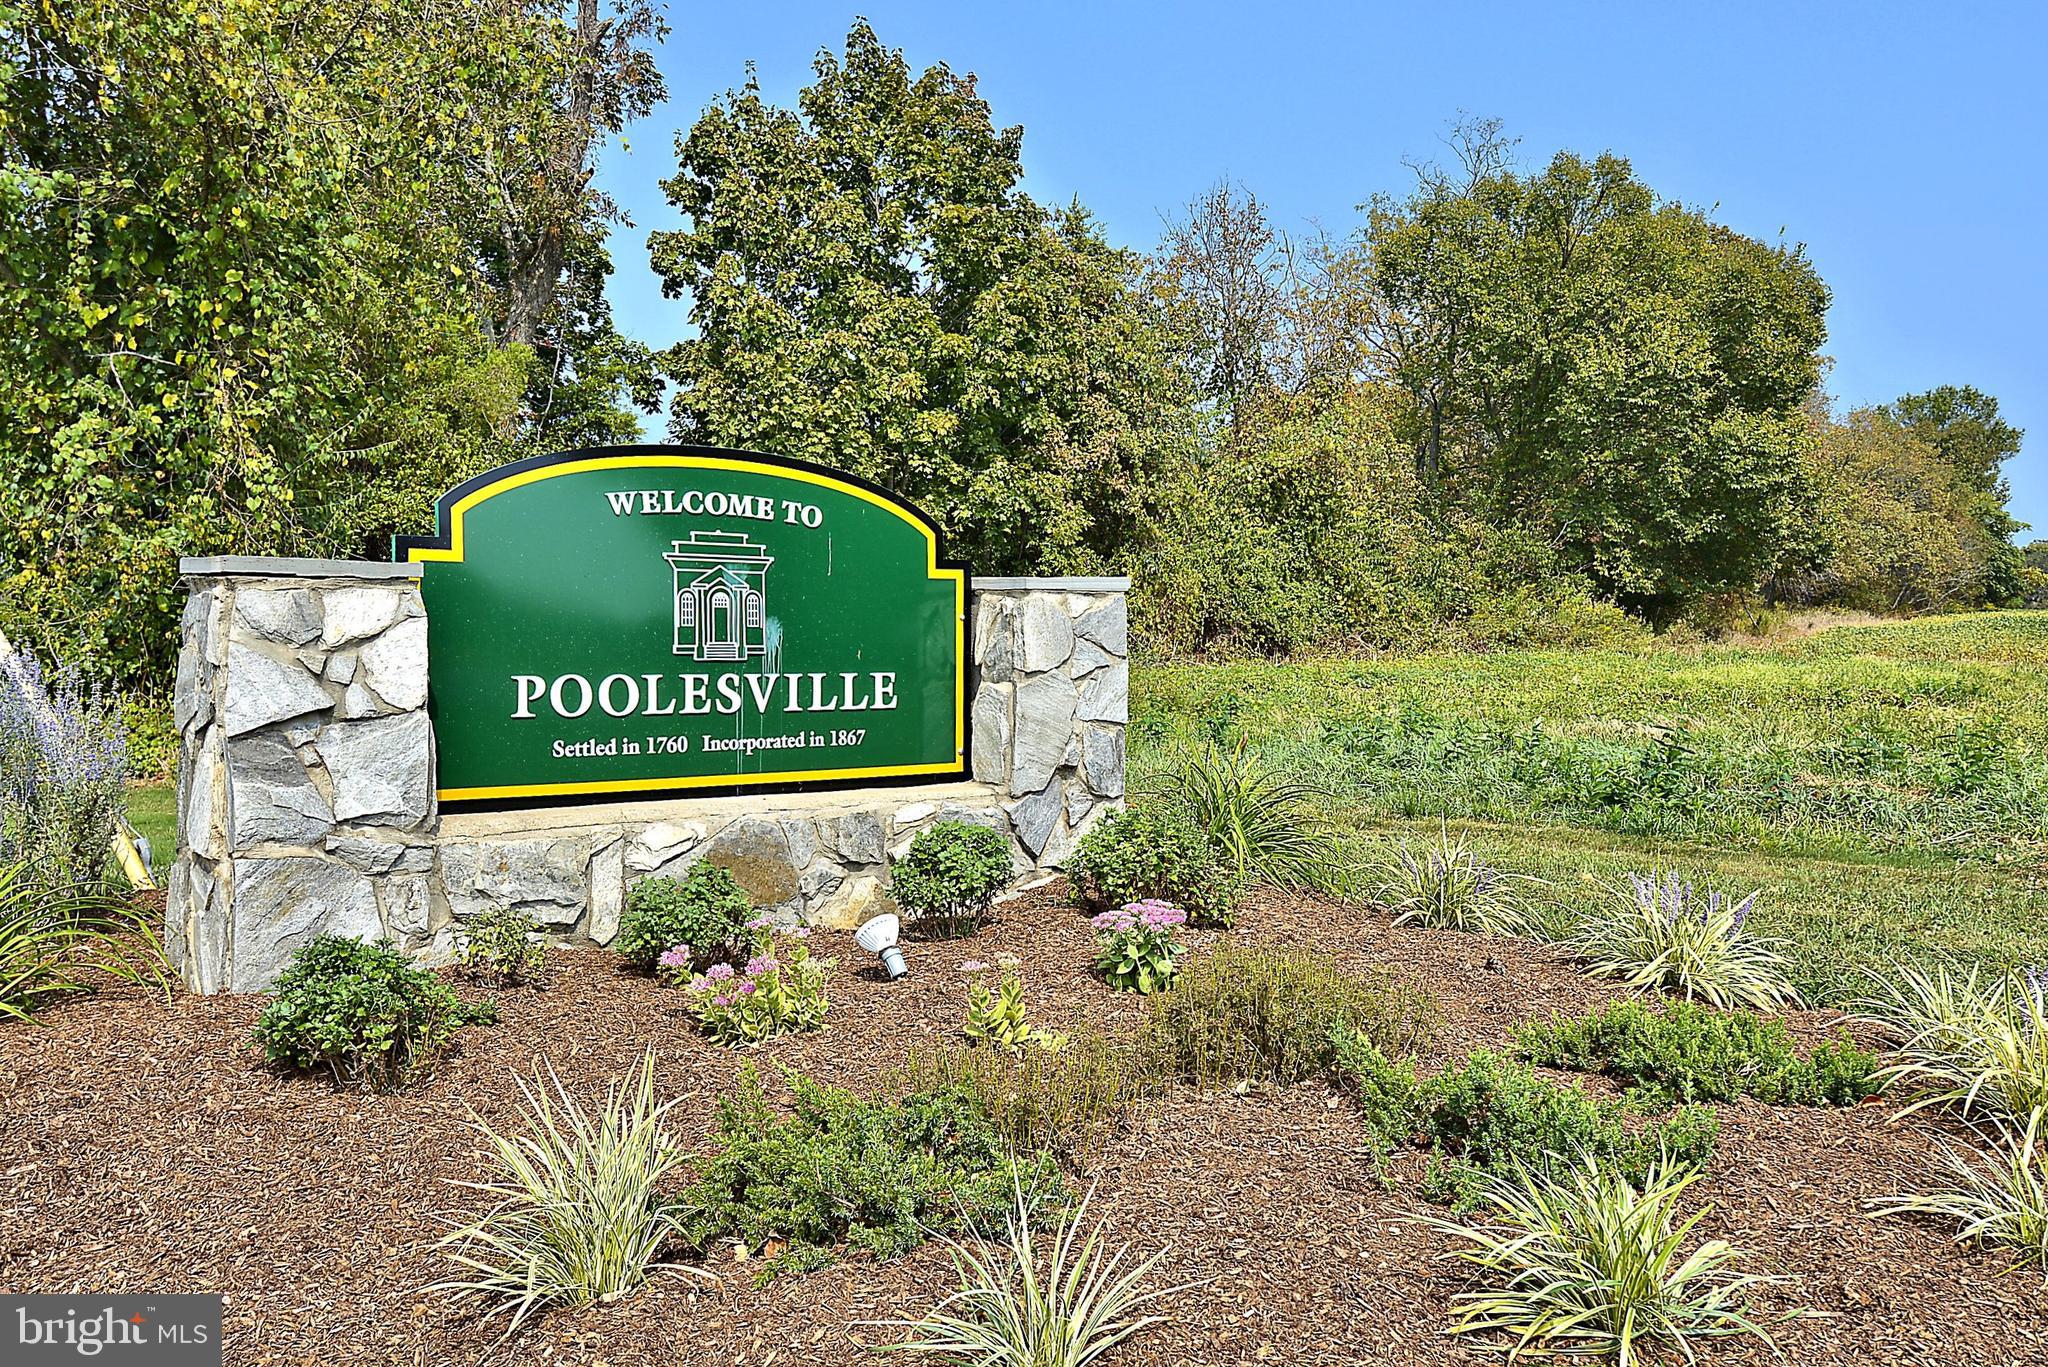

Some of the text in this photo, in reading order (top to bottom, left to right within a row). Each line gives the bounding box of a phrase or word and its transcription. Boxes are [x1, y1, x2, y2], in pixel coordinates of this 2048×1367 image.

[605, 490, 823, 528] WELCOME TO
[511, 672, 898, 718] POOLESVILLE
[552, 729, 866, 758] Settled in 1760 Incorporated in 1867
